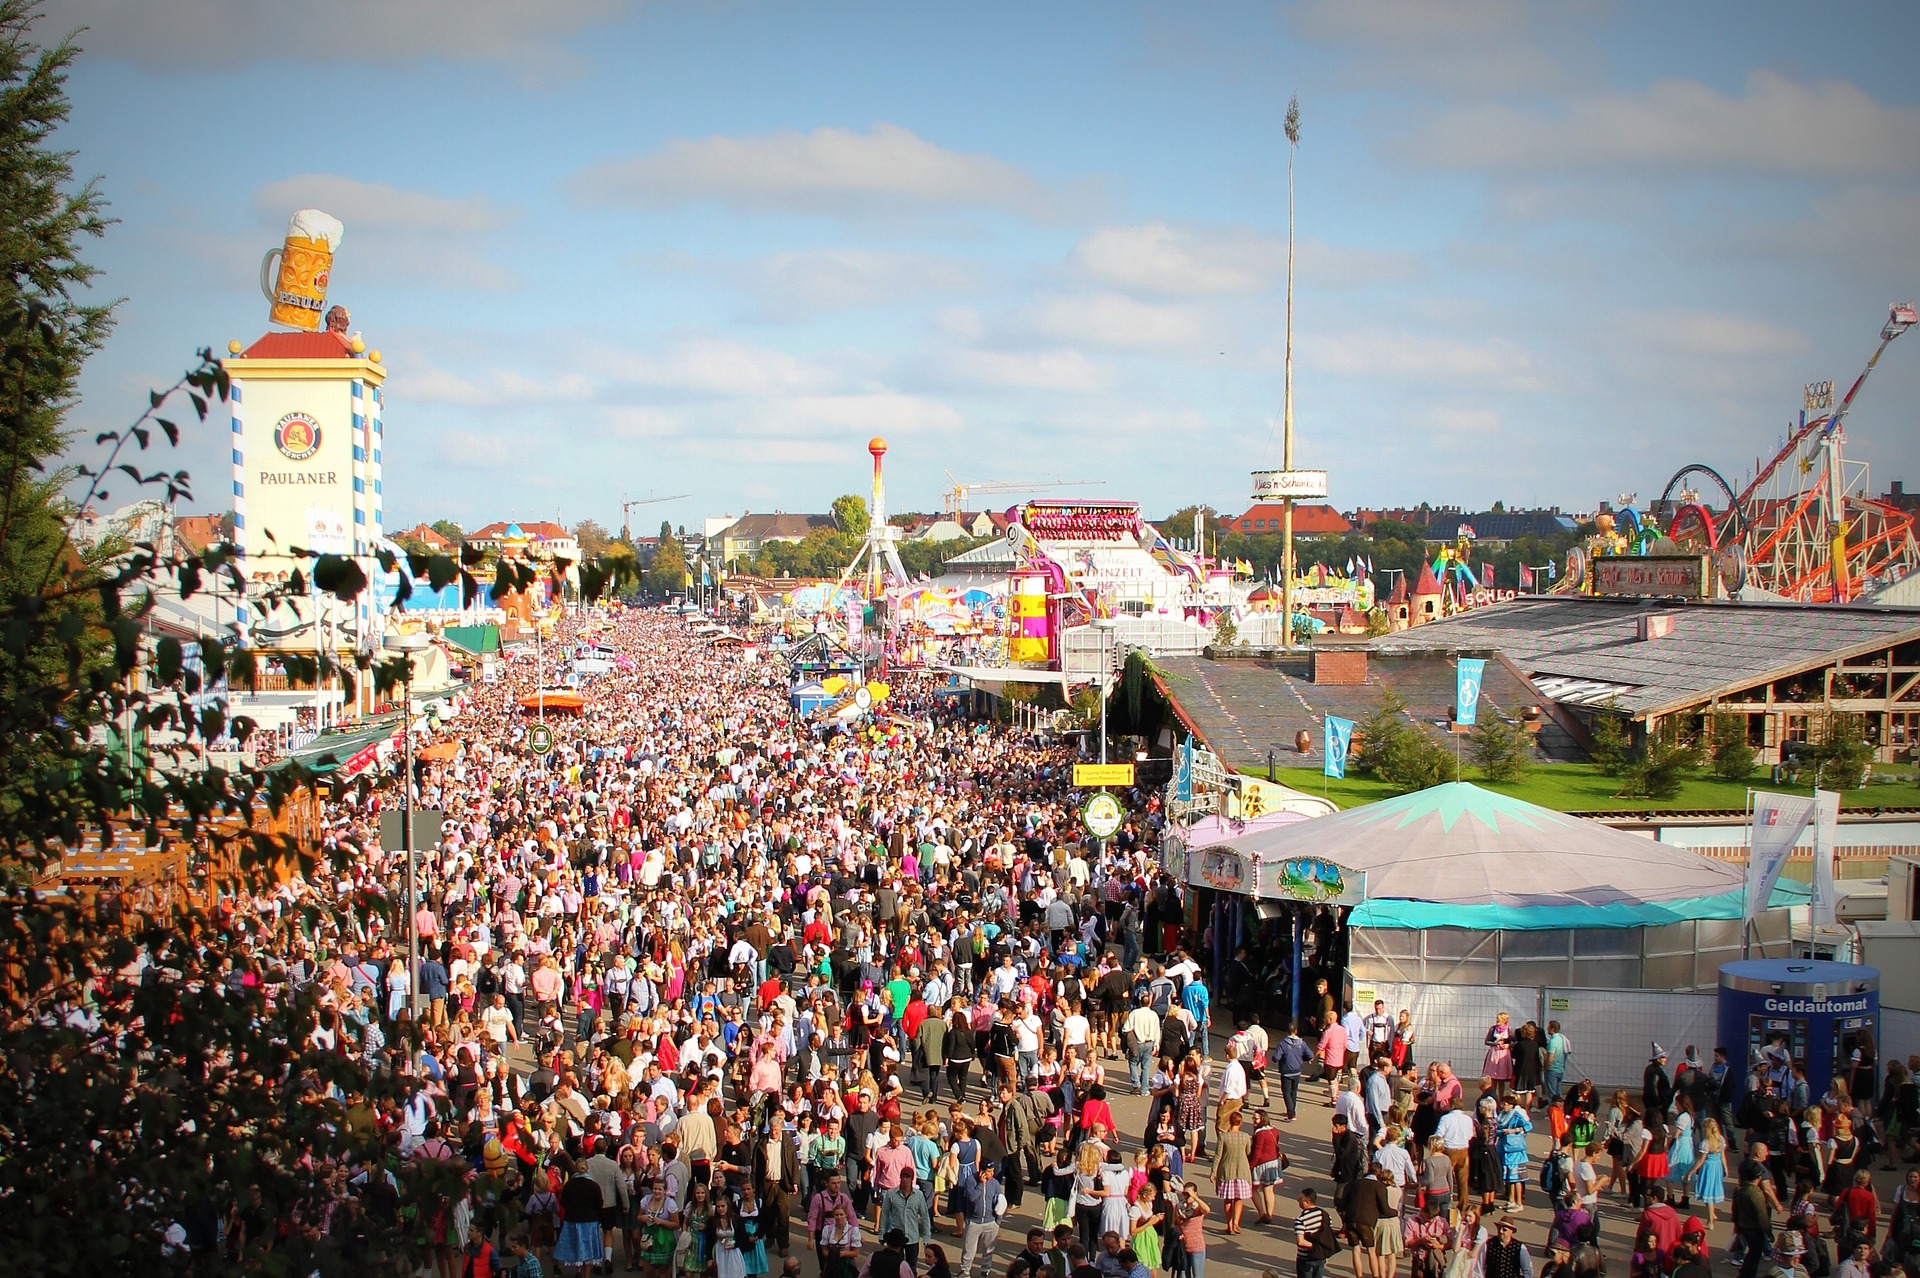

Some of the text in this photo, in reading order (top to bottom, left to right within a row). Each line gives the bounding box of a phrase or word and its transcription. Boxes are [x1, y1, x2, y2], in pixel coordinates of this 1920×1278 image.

[276, 412, 320, 431] PAULANER
[259, 472, 337, 484] PAULANER
[1764, 998, 1867, 1013] Geldautomat
